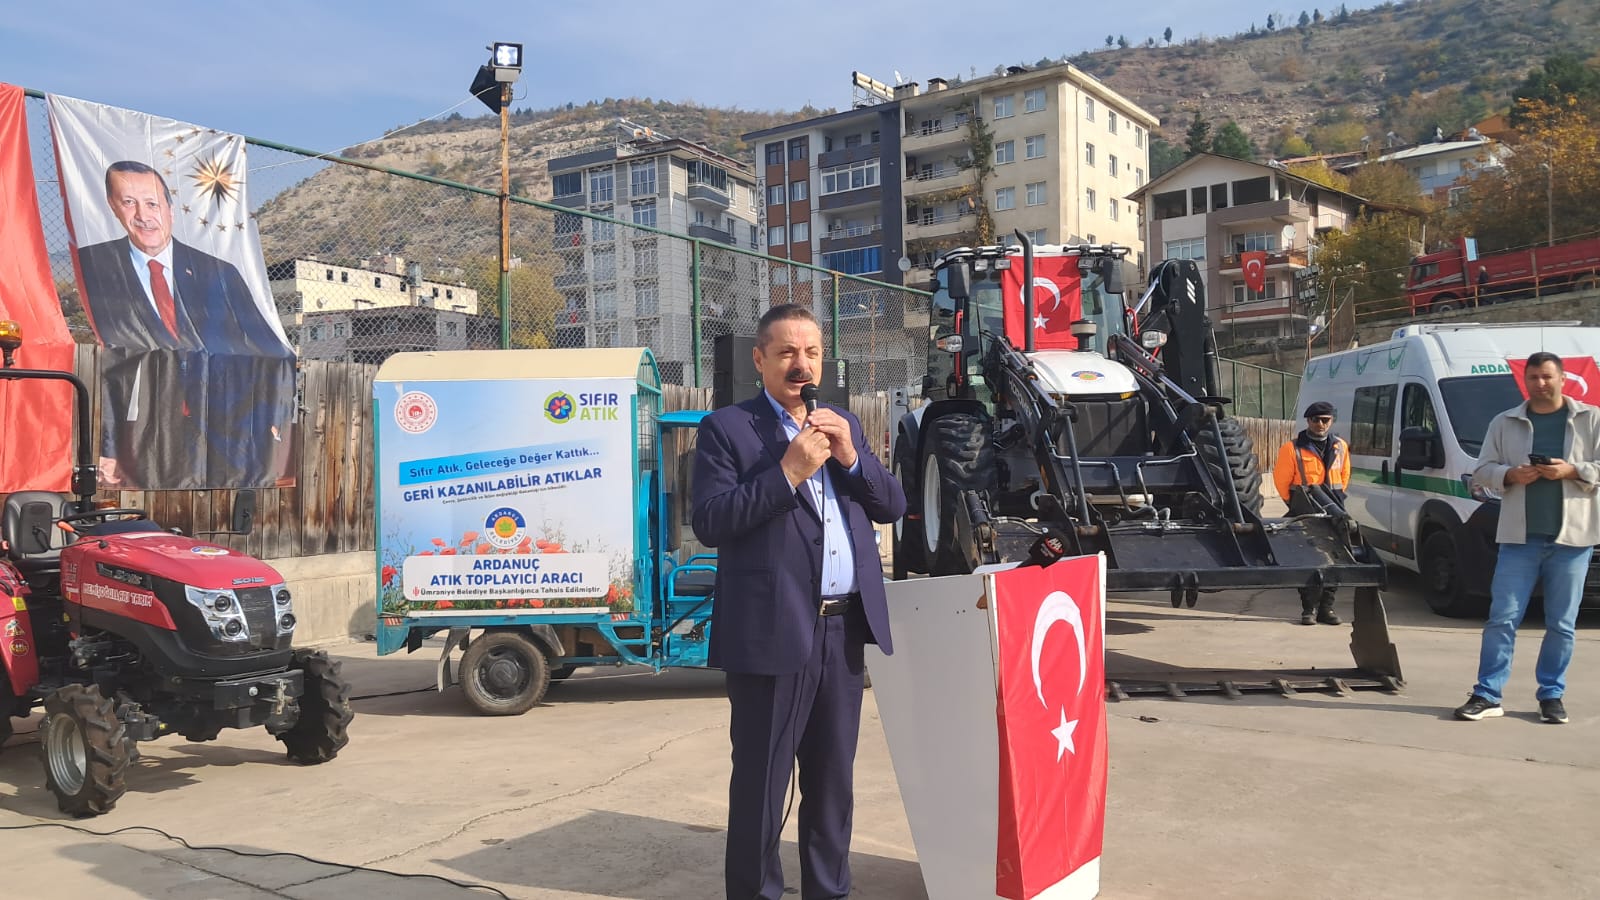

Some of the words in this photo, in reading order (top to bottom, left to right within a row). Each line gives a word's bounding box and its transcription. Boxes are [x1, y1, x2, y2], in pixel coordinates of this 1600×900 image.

[758, 179, 766, 246] AKSAKAL
[579, 393, 618, 406] SIFIR
[580, 407, 618, 420] ATIK
[410, 467, 433, 478] Sıfır
[437, 464, 463, 474] Atık,
[465, 457, 516, 471] Geleceğe
[519, 453, 552, 464] Değer
[555, 447, 599, 459] Kattık...
[403, 486, 434, 502] GERİ
[437, 473, 540, 498] KAZANILABİLİR
[545, 467, 602, 485] ATIKLAR
[473, 558, 540, 571] ARDANUÇ
[430, 574, 462, 586] ATIK
[466, 573, 537, 585] TOPLAYICI
[541, 572, 583, 584] ARACI
